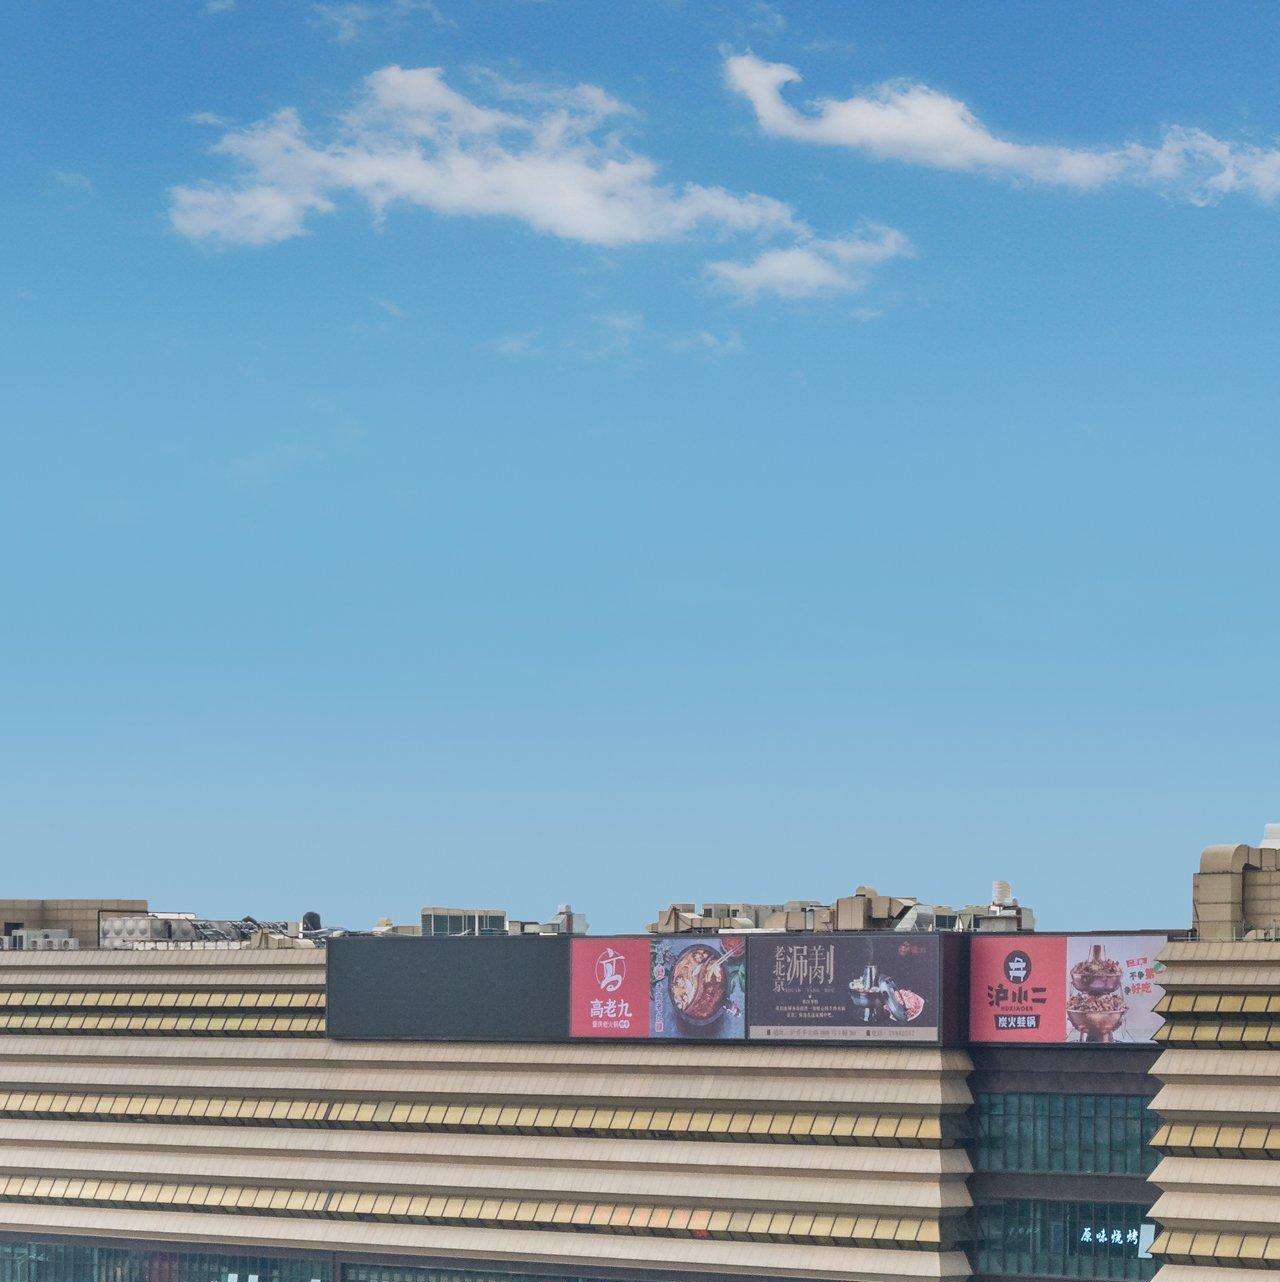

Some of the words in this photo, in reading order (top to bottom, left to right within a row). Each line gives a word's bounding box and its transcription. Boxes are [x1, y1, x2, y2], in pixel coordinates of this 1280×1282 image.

[590, 999, 632, 1018] 高老九
[1081, 1227, 1139, 1245] 原味烧烤
